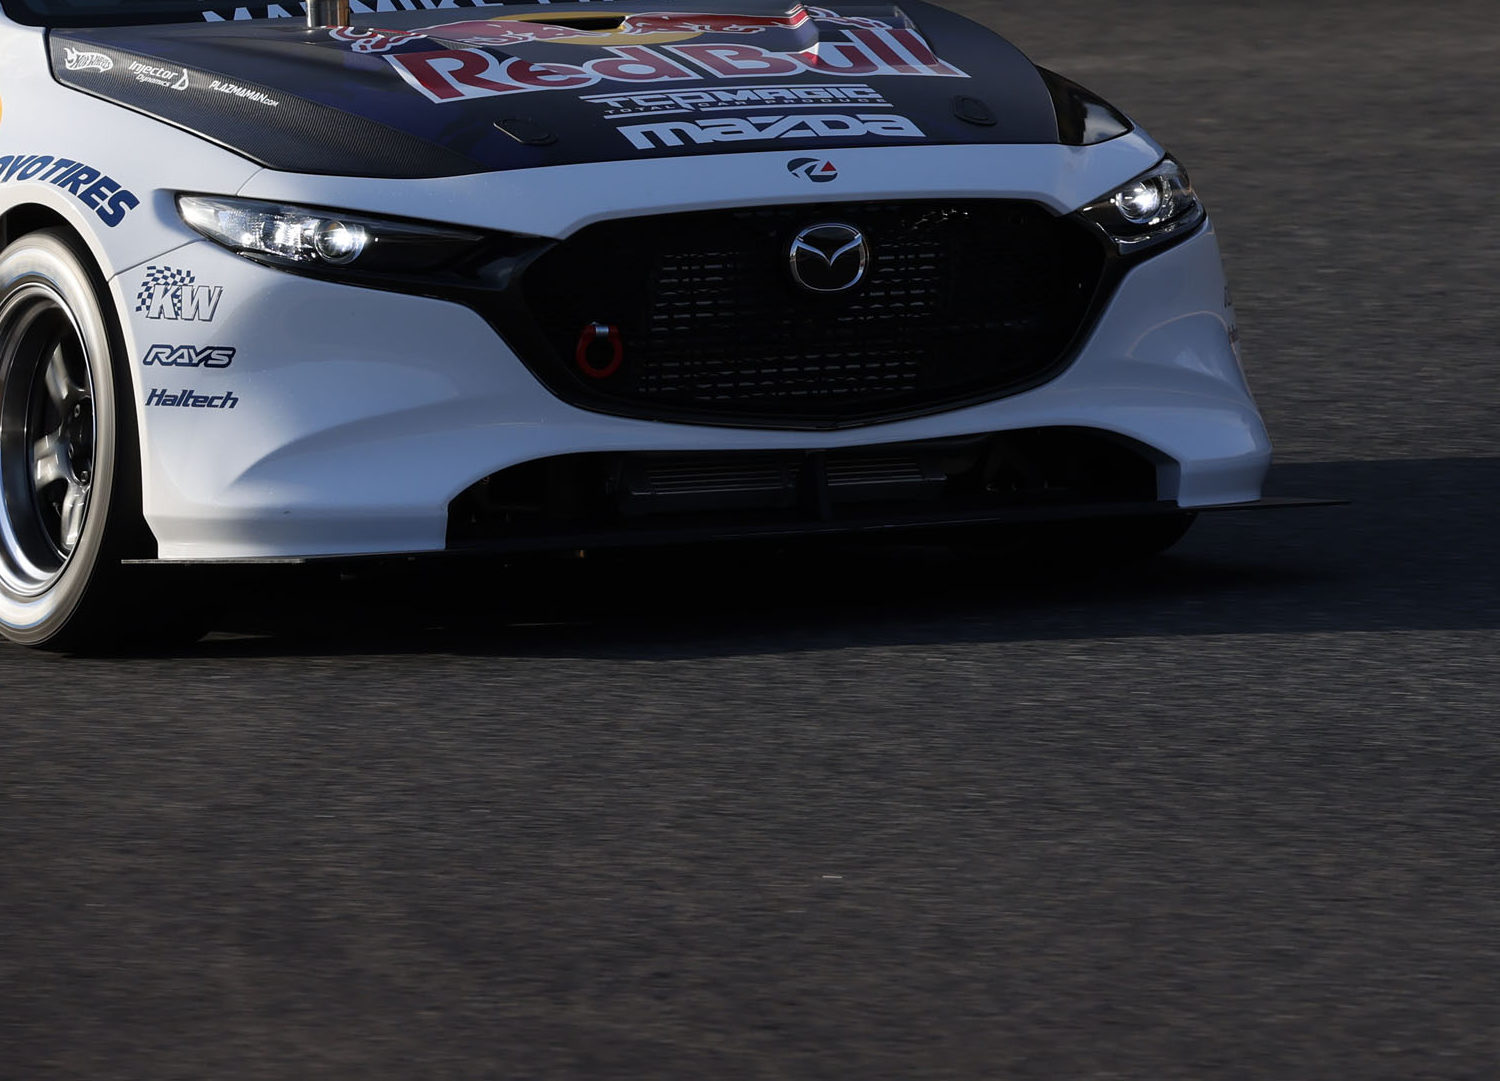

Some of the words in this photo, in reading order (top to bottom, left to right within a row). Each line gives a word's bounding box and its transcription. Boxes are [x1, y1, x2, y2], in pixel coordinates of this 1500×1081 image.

[129, 60, 178, 80] Injector
[387, 44, 697, 101] Red
[682, 29, 965, 78] Bull
[136, 73, 171, 88] Dynamics
[604, 105, 675, 114] TOTAL
[147, 283, 223, 322] KW
[143, 345, 236, 368] RAYS
[145, 388, 239, 409] Haltech
